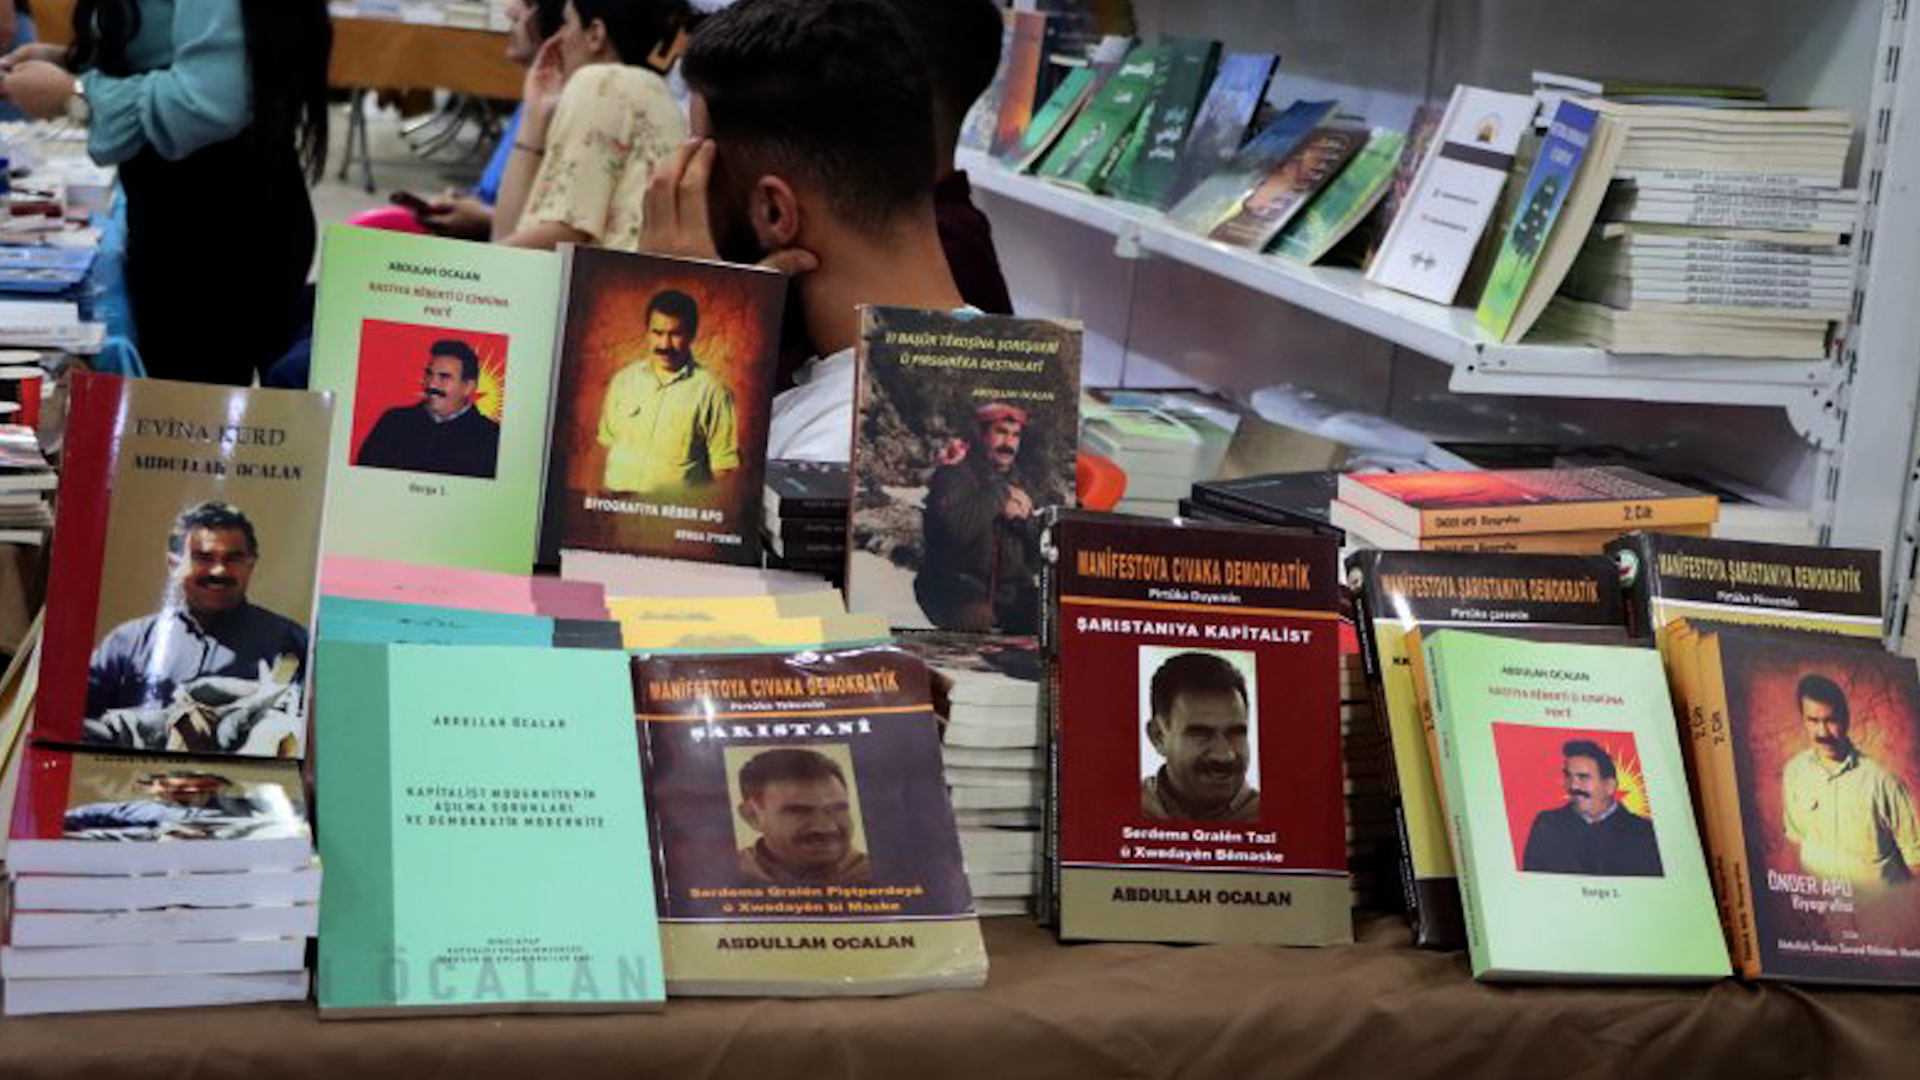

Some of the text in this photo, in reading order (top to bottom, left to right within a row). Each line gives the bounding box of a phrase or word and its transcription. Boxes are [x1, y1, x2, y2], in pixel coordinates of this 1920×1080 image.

[700, 509, 723, 523] APO
[1122, 825, 1190, 841] Serdema
[1111, 886, 1292, 906] ABDULLAH OCALAN
[716, 935, 915, 950] ABDULLAH OCALAN
